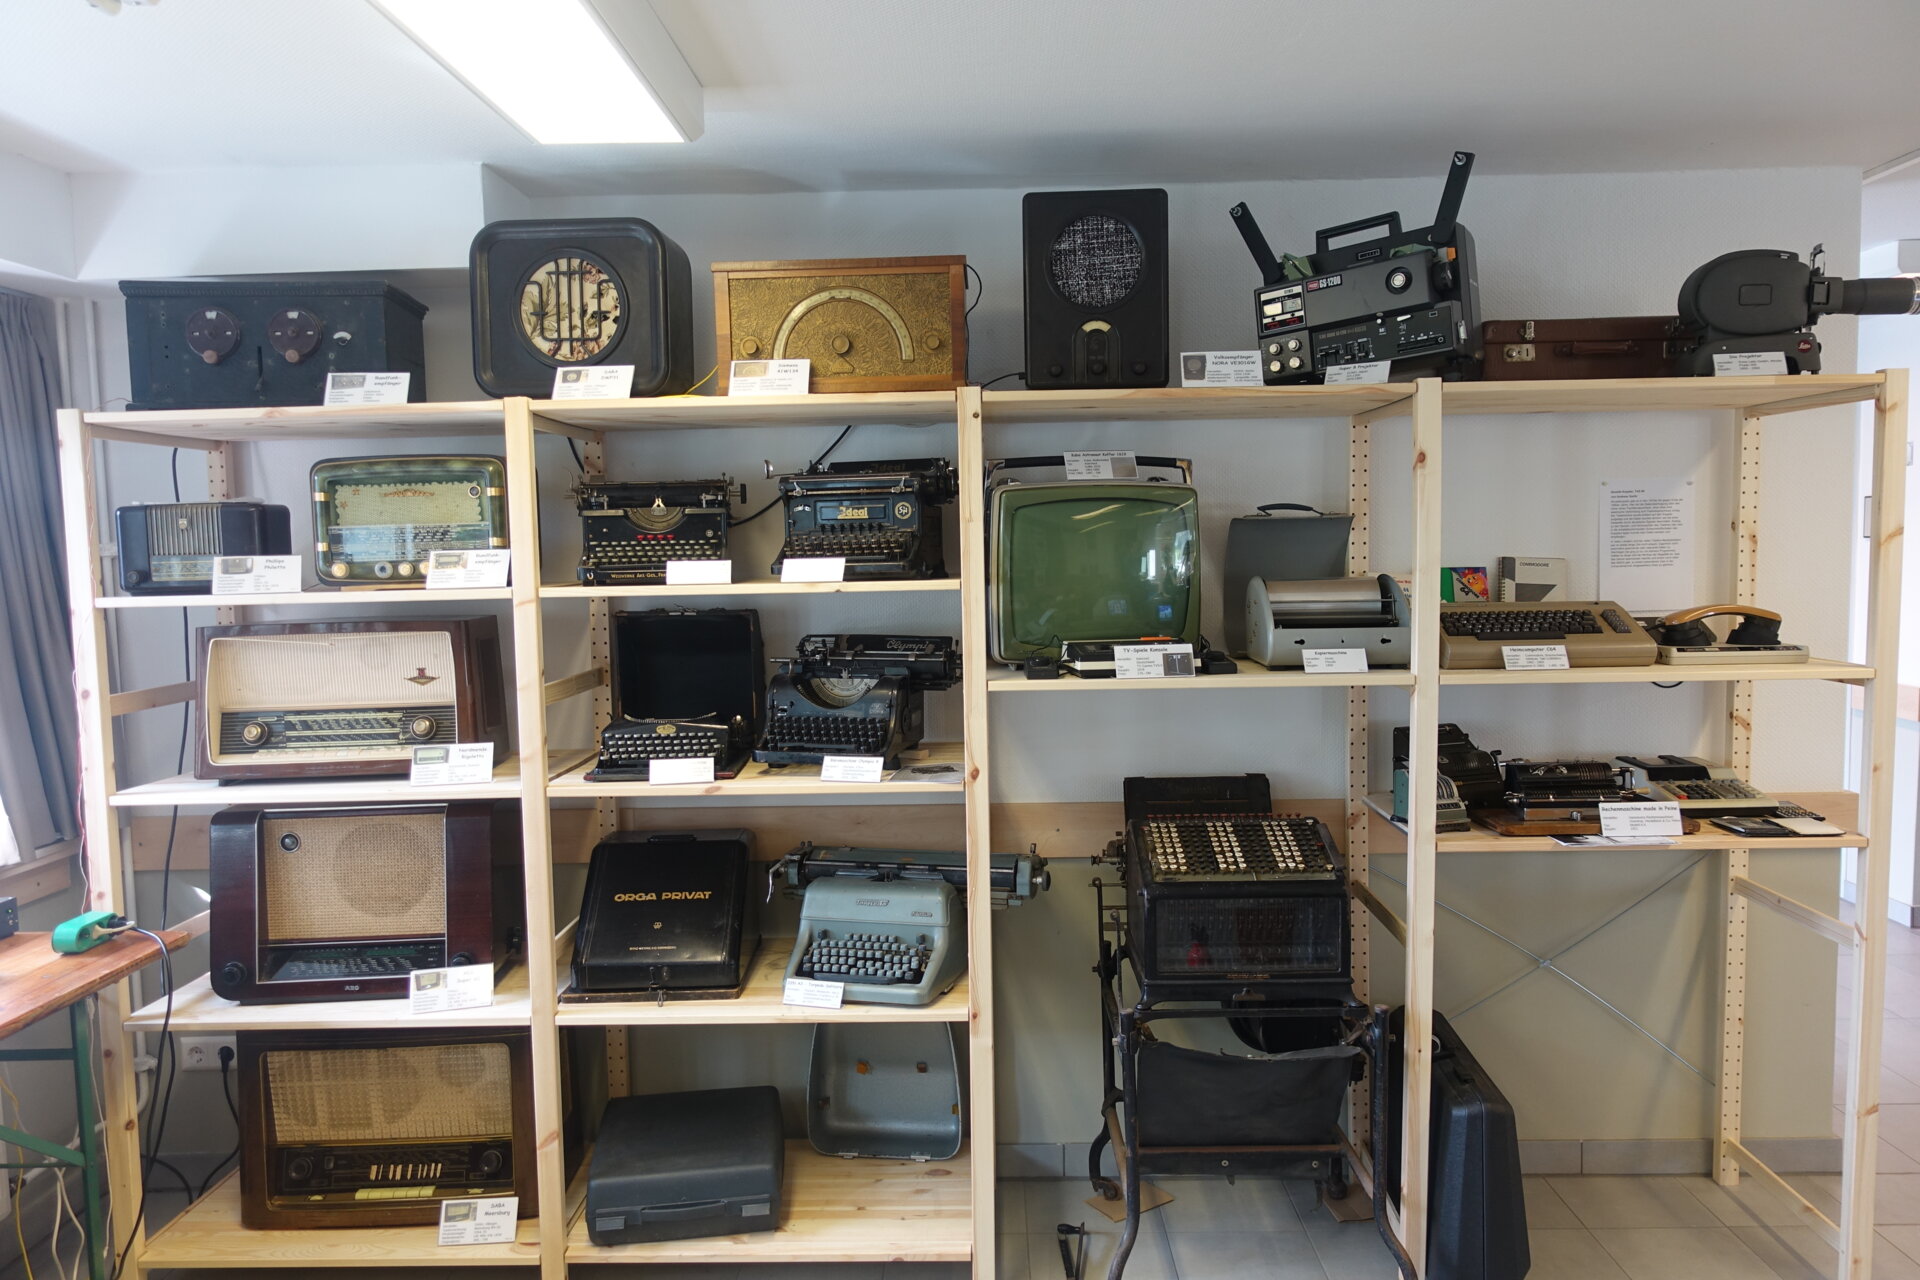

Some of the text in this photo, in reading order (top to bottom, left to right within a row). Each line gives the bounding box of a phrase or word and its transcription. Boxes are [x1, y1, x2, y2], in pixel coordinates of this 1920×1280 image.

[1319, 276, 1341, 288] GS-1200
[837, 506, 868, 519] Ideal
[886, 639, 930, 652] Olympi
[614, 891, 712, 902] ORGA PRIVAT
